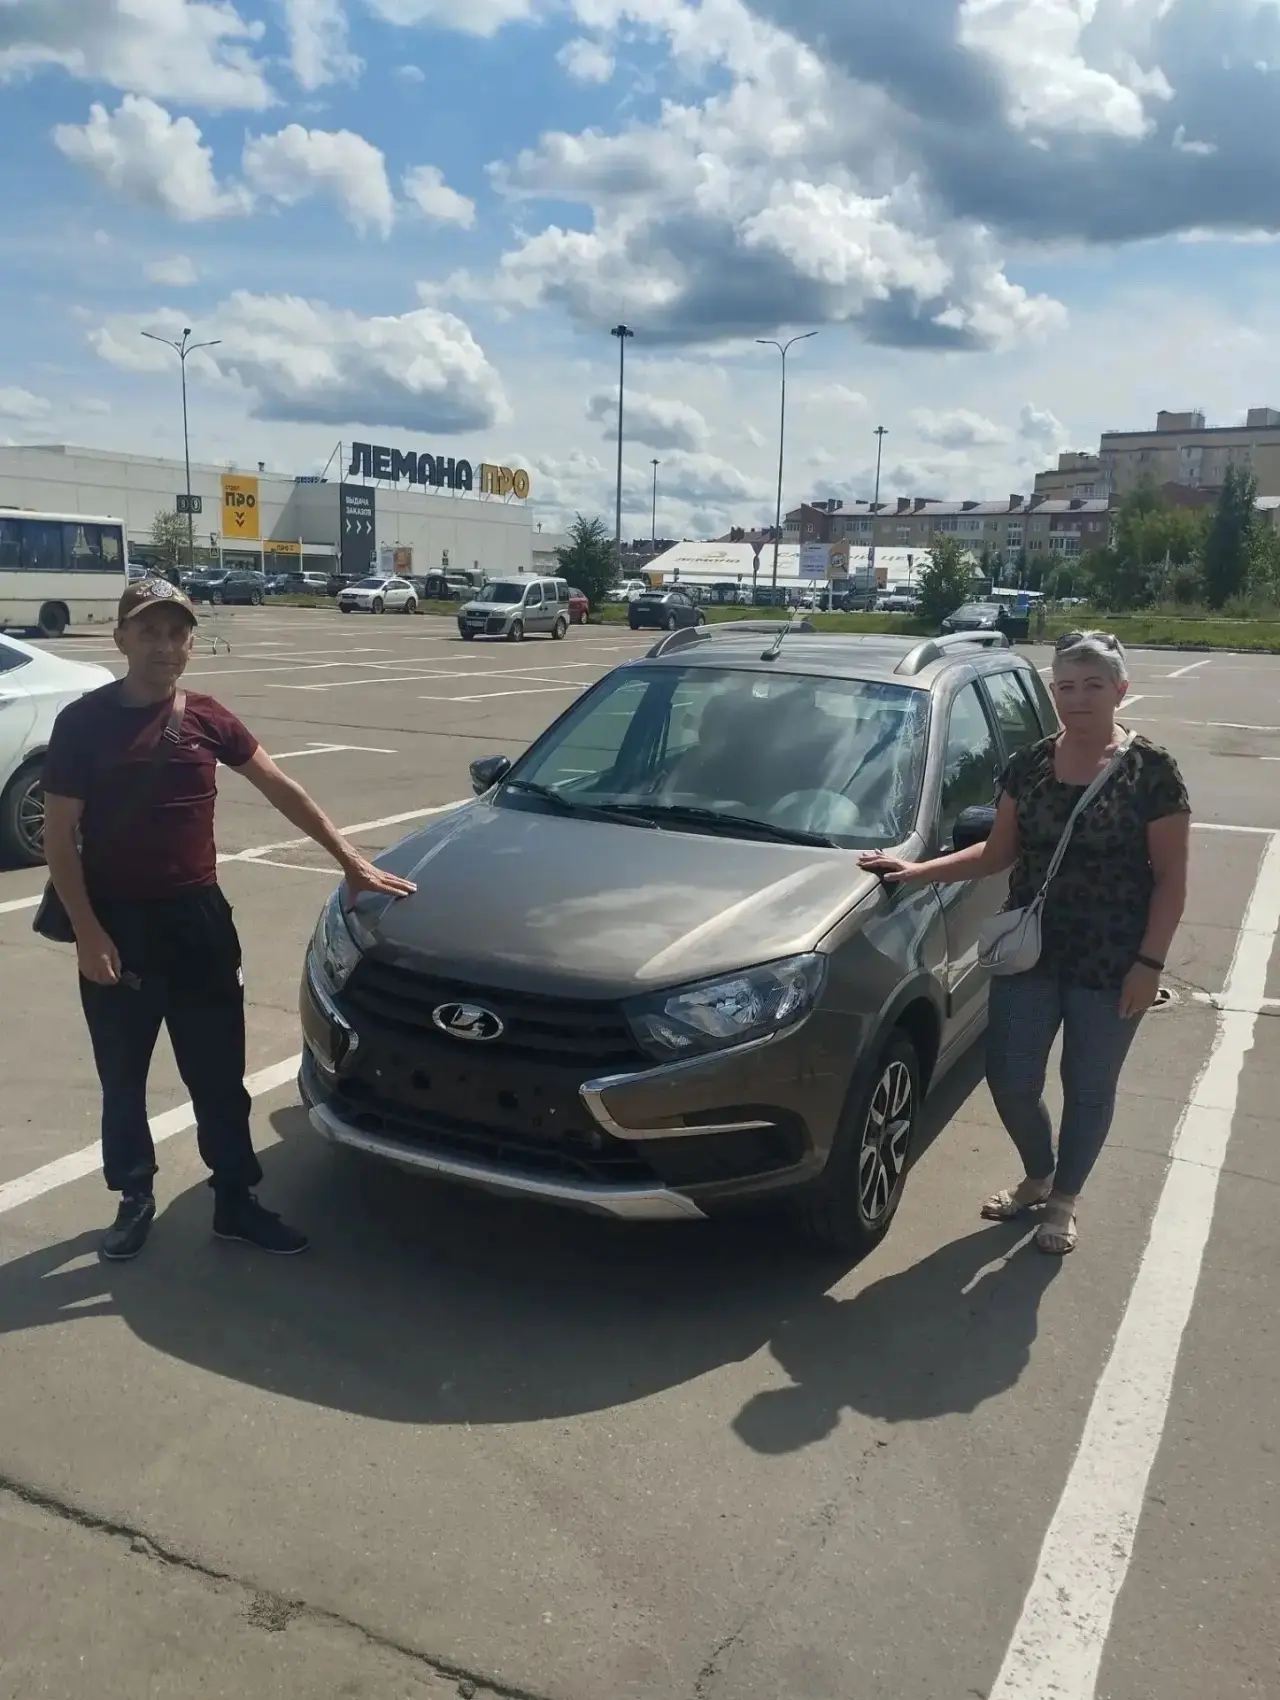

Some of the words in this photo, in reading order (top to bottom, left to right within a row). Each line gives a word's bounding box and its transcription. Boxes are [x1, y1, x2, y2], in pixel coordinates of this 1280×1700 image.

[349, 441, 473, 491] ЛЕМАНА
[480, 463, 530, 499] ПРО
[225, 491, 256, 508] ПРО
